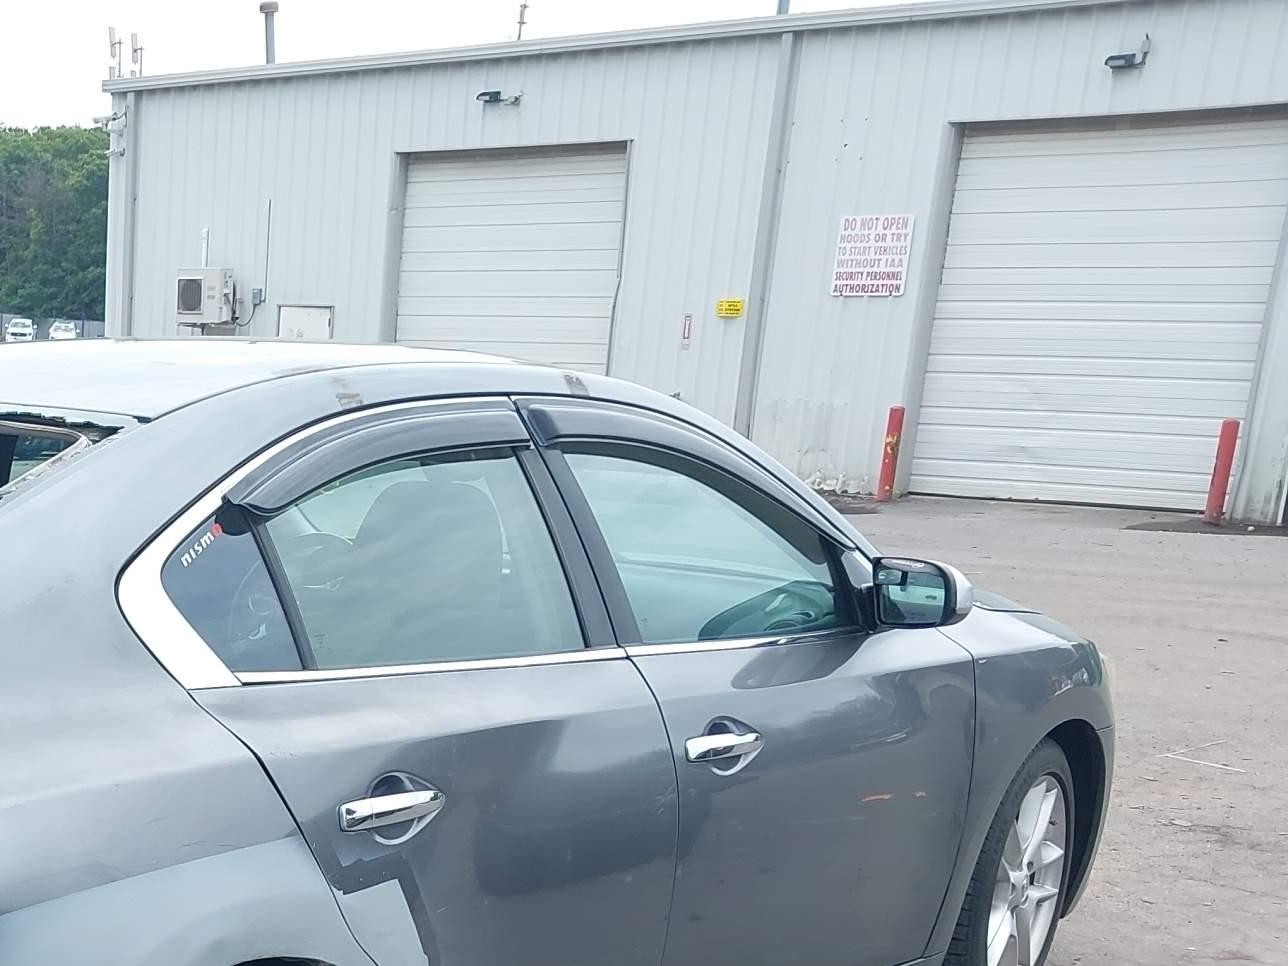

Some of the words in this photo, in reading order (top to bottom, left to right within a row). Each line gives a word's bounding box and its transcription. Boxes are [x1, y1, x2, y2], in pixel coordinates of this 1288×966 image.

[843, 218, 857, 231] DO
[859, 217, 880, 231] NOT
[882, 216, 909, 230] OPEN
[839, 233, 872, 243] HOODS
[874, 233, 888, 243] OR
[890, 232, 909, 243] TRY
[837, 246, 847, 257] TO
[848, 246, 872, 257] START
[873, 245, 908, 256] VEHICLES
[836, 258, 882, 268] WITHOUT
[884, 258, 904, 268] IAA
[834, 271, 864, 281] SECURITY
[865, 270, 903, 280] PERSONNEL
[832, 283, 901, 293] AUTHORIZATION
